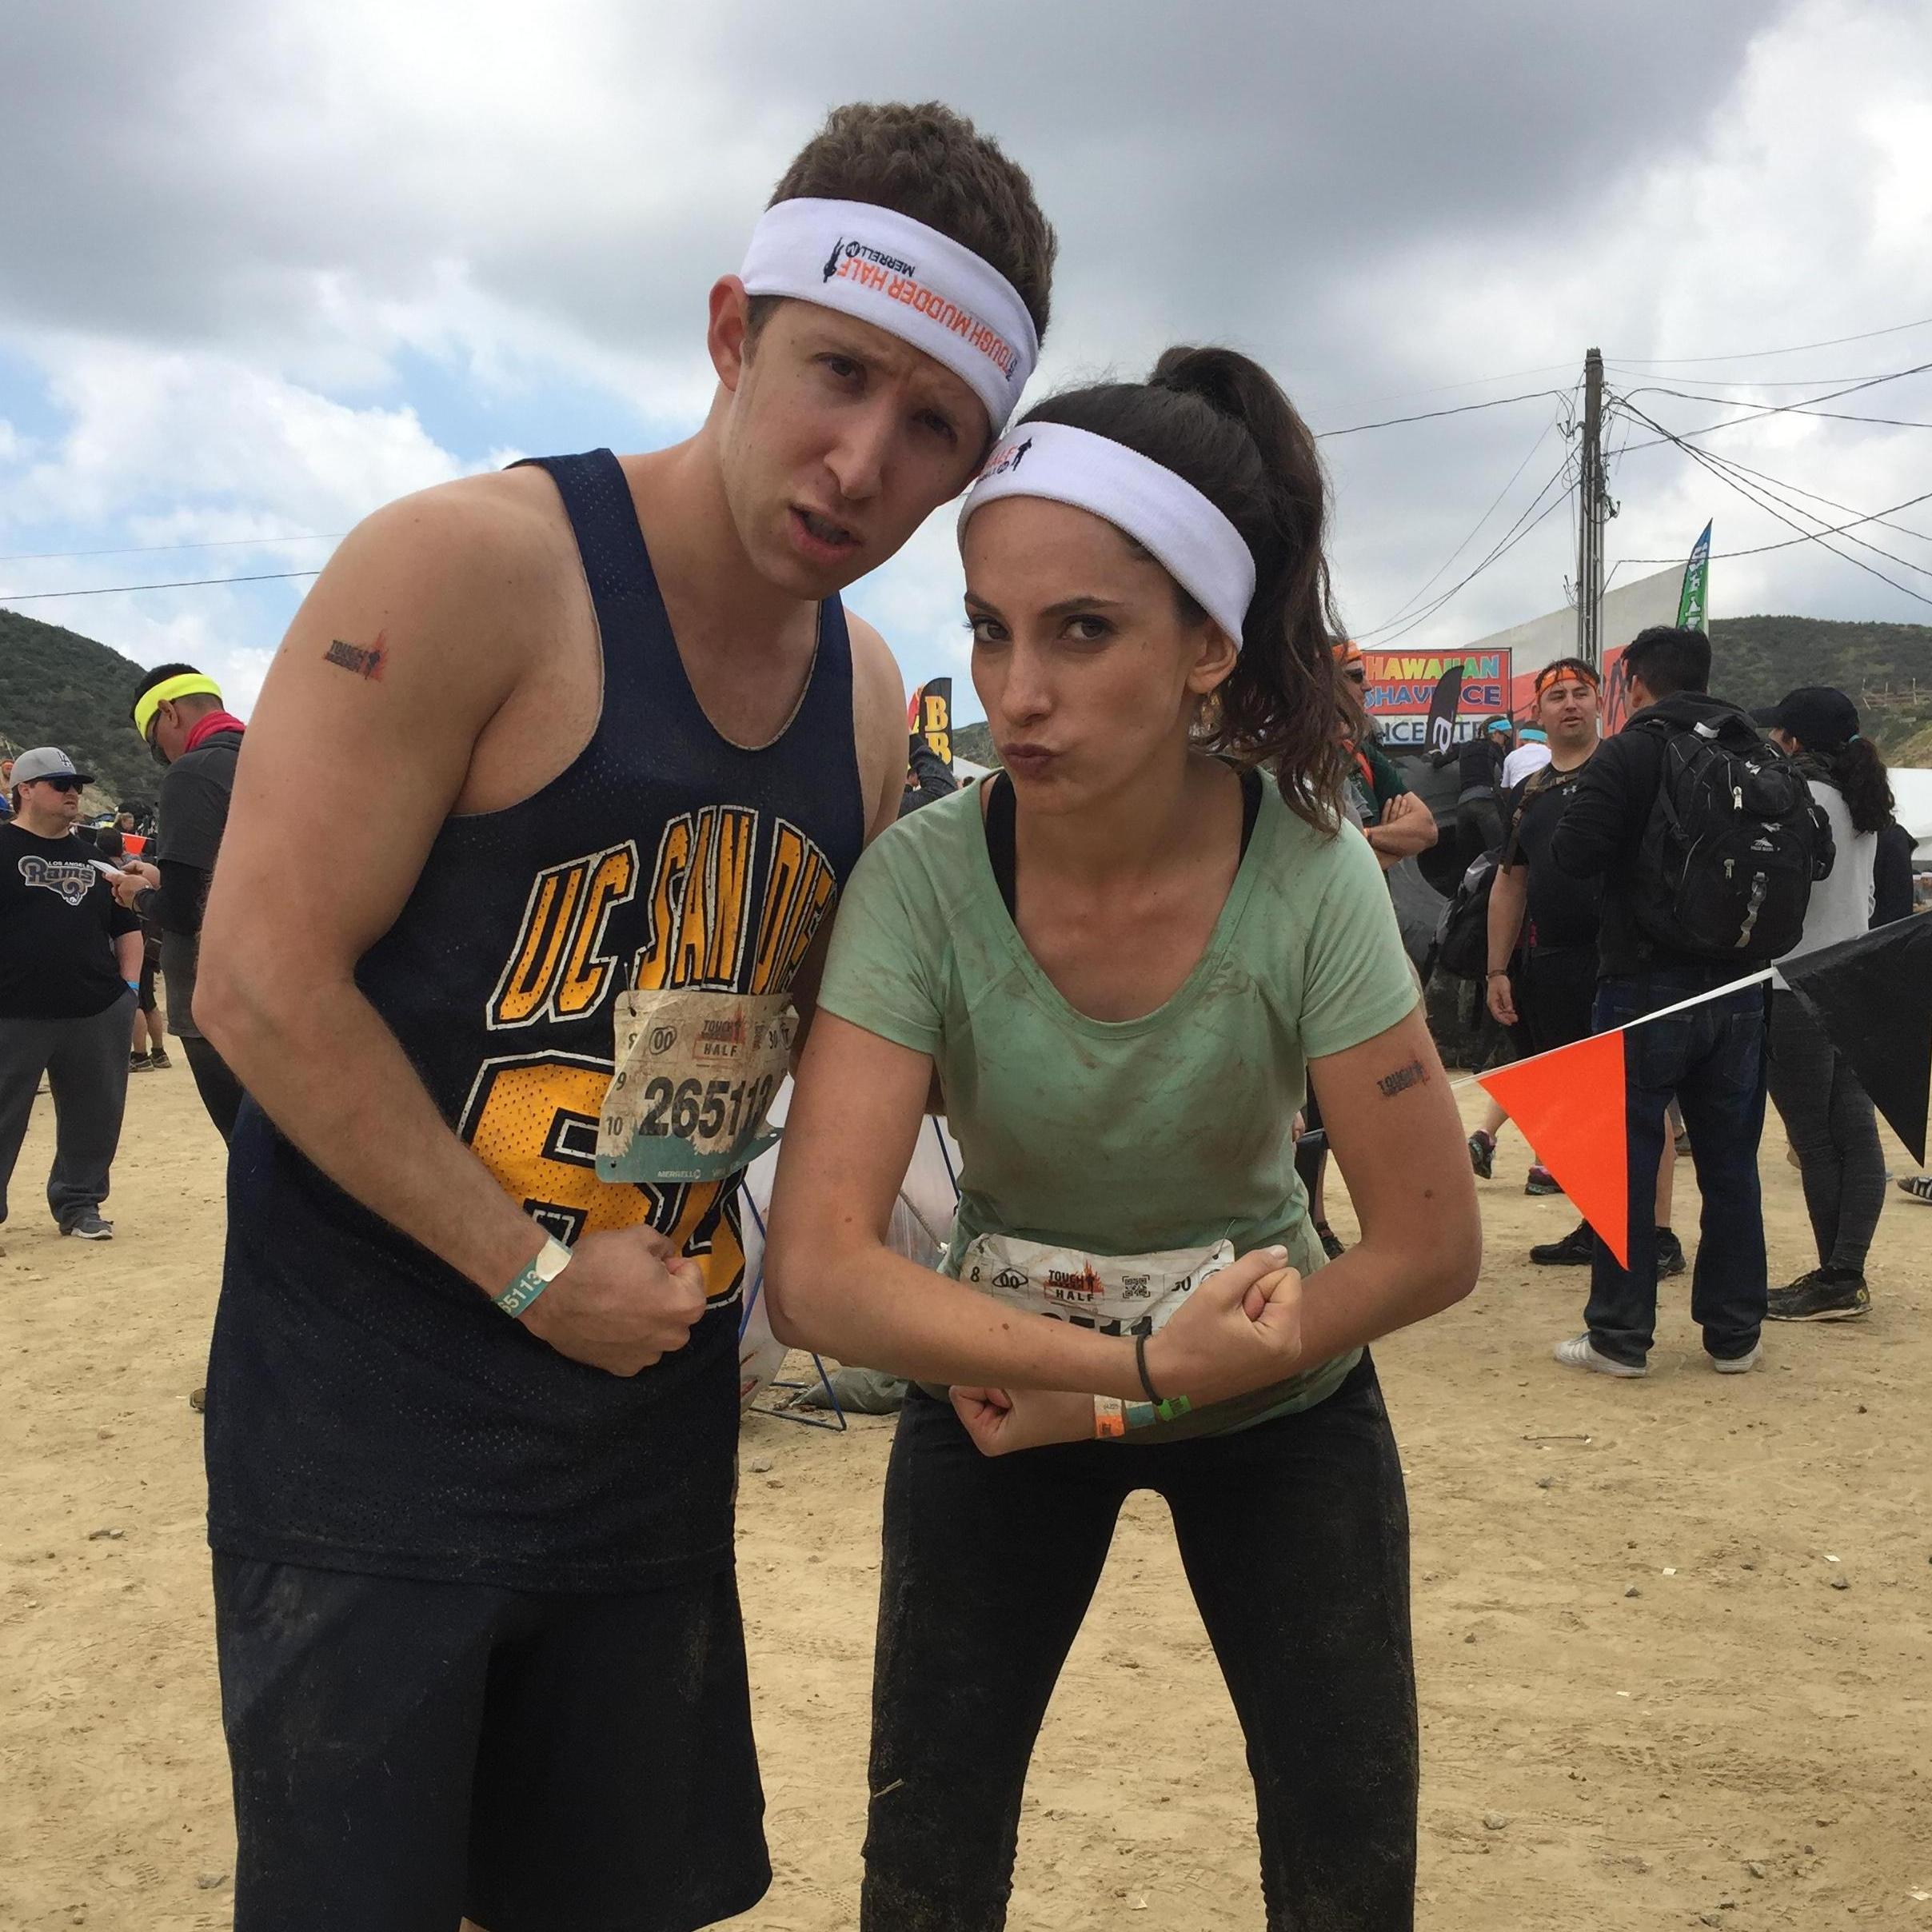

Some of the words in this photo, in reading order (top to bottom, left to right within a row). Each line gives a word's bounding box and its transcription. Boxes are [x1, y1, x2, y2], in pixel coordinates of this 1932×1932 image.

[860, 245, 916, 277] MERRELL
[837, 256, 889, 292] HALF
[888, 274, 972, 338] MUDDER
[965, 321, 1013, 374] TOUGH
[1363, 685, 1437, 709] SHAV
[1459, 684, 1502, 707] CE
[18, 856, 95, 888] Rams
[64, 861, 94, 871] ANGELES
[486, 839, 640, 1031] UC
[633, 804, 758, 993] SAN
[703, 1043, 738, 1057] HALF
[616, 1072, 627, 1091] 9
[606, 1116, 624, 1136] 10
[970, 1266, 980, 1283] 8
[1056, 1288, 1095, 1302] HALF
